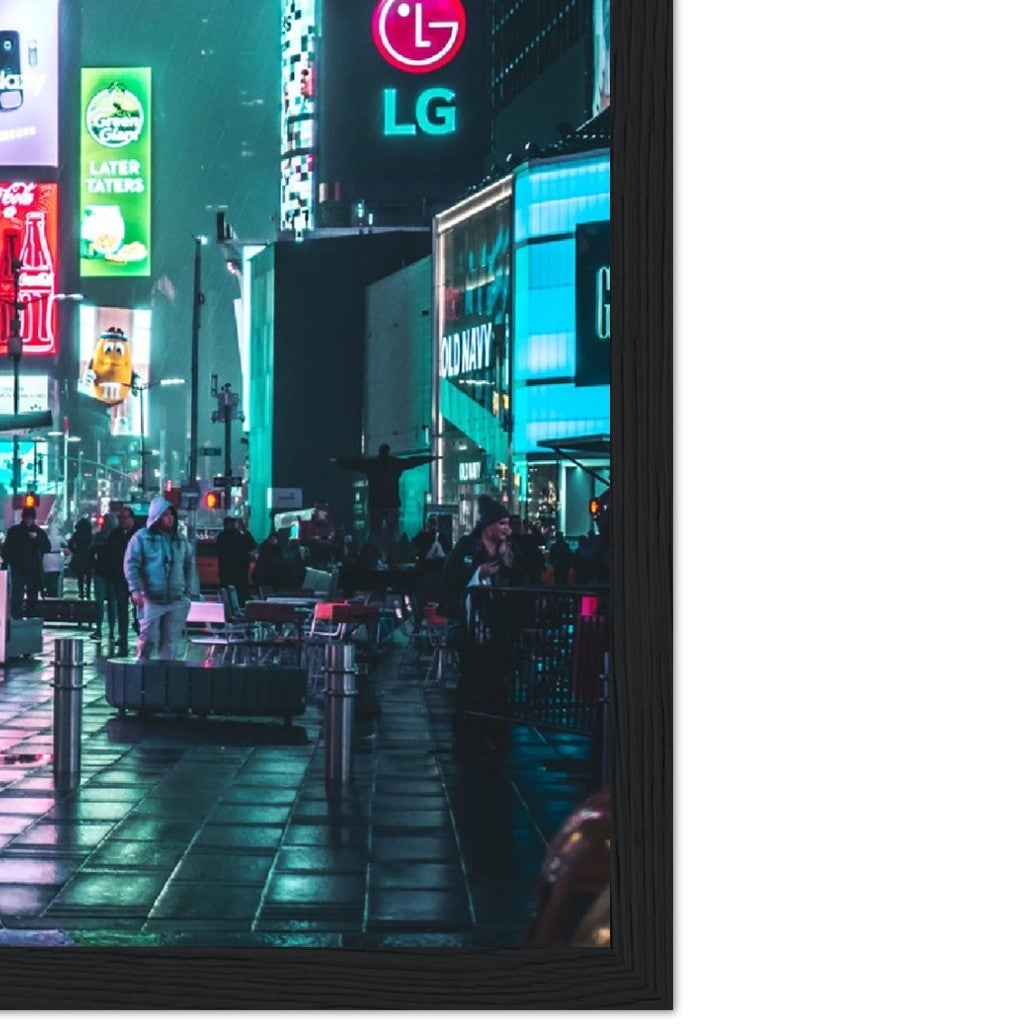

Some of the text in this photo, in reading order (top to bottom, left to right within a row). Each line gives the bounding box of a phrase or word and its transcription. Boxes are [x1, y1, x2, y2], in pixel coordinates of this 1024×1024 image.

[383, 88, 457, 136] LG
[96, 116, 140, 130] Green
[89, 159, 140, 176] LATER
[86, 177, 145, 193] TATERS
[441, 322, 493, 378] OLD NAVY
